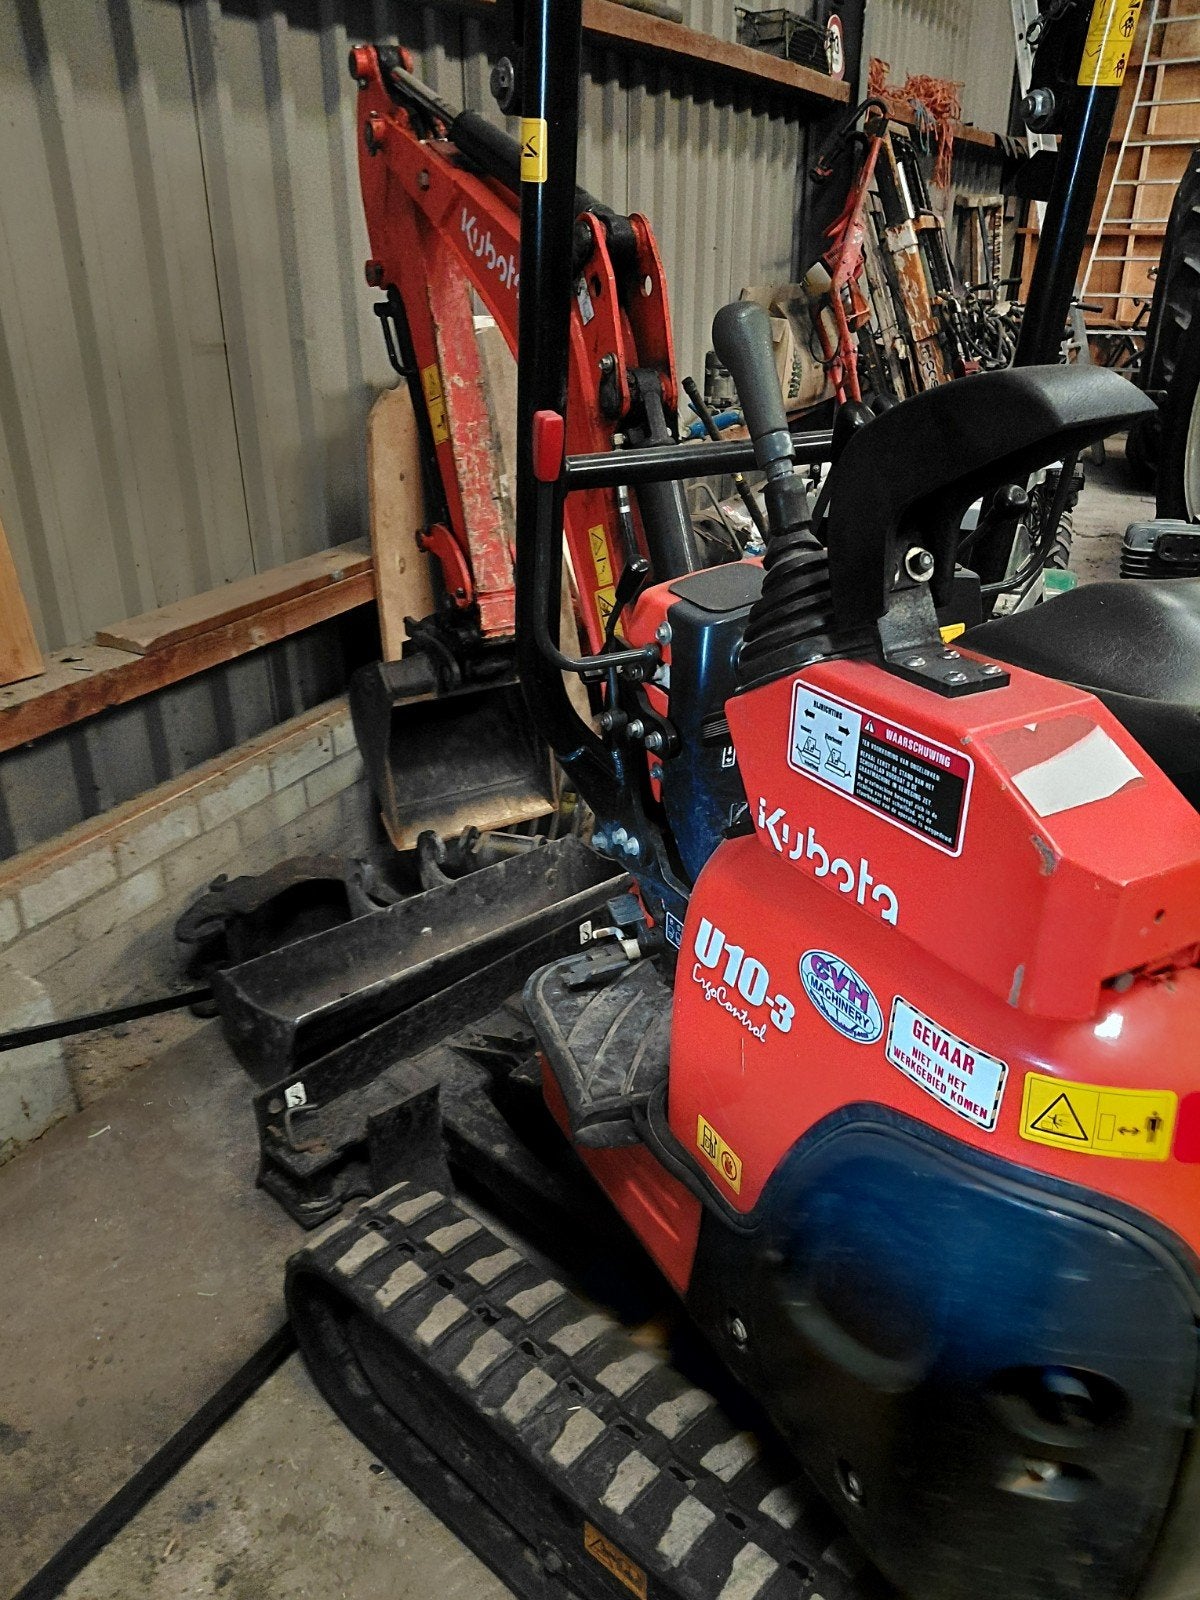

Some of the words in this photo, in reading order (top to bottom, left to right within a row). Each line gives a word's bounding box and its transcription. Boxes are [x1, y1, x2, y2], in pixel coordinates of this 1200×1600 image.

[886, 729, 951, 767] WAARSCHUWING
[758, 797, 898, 926] Kubota
[694, 917, 795, 1032] U10-3
[811, 955, 869, 1014] CVH
[811, 976, 869, 1028] MACHINERY
[912, 1046, 931, 1067] NIET
[935, 1064, 944, 1077] IN
[948, 1073, 967, 1092] HET
[913, 1020, 975, 1075] GEVAAR
[894, 1046, 946, 1094] WERKGEBIED
[950, 1090, 987, 1119] KOMEN
